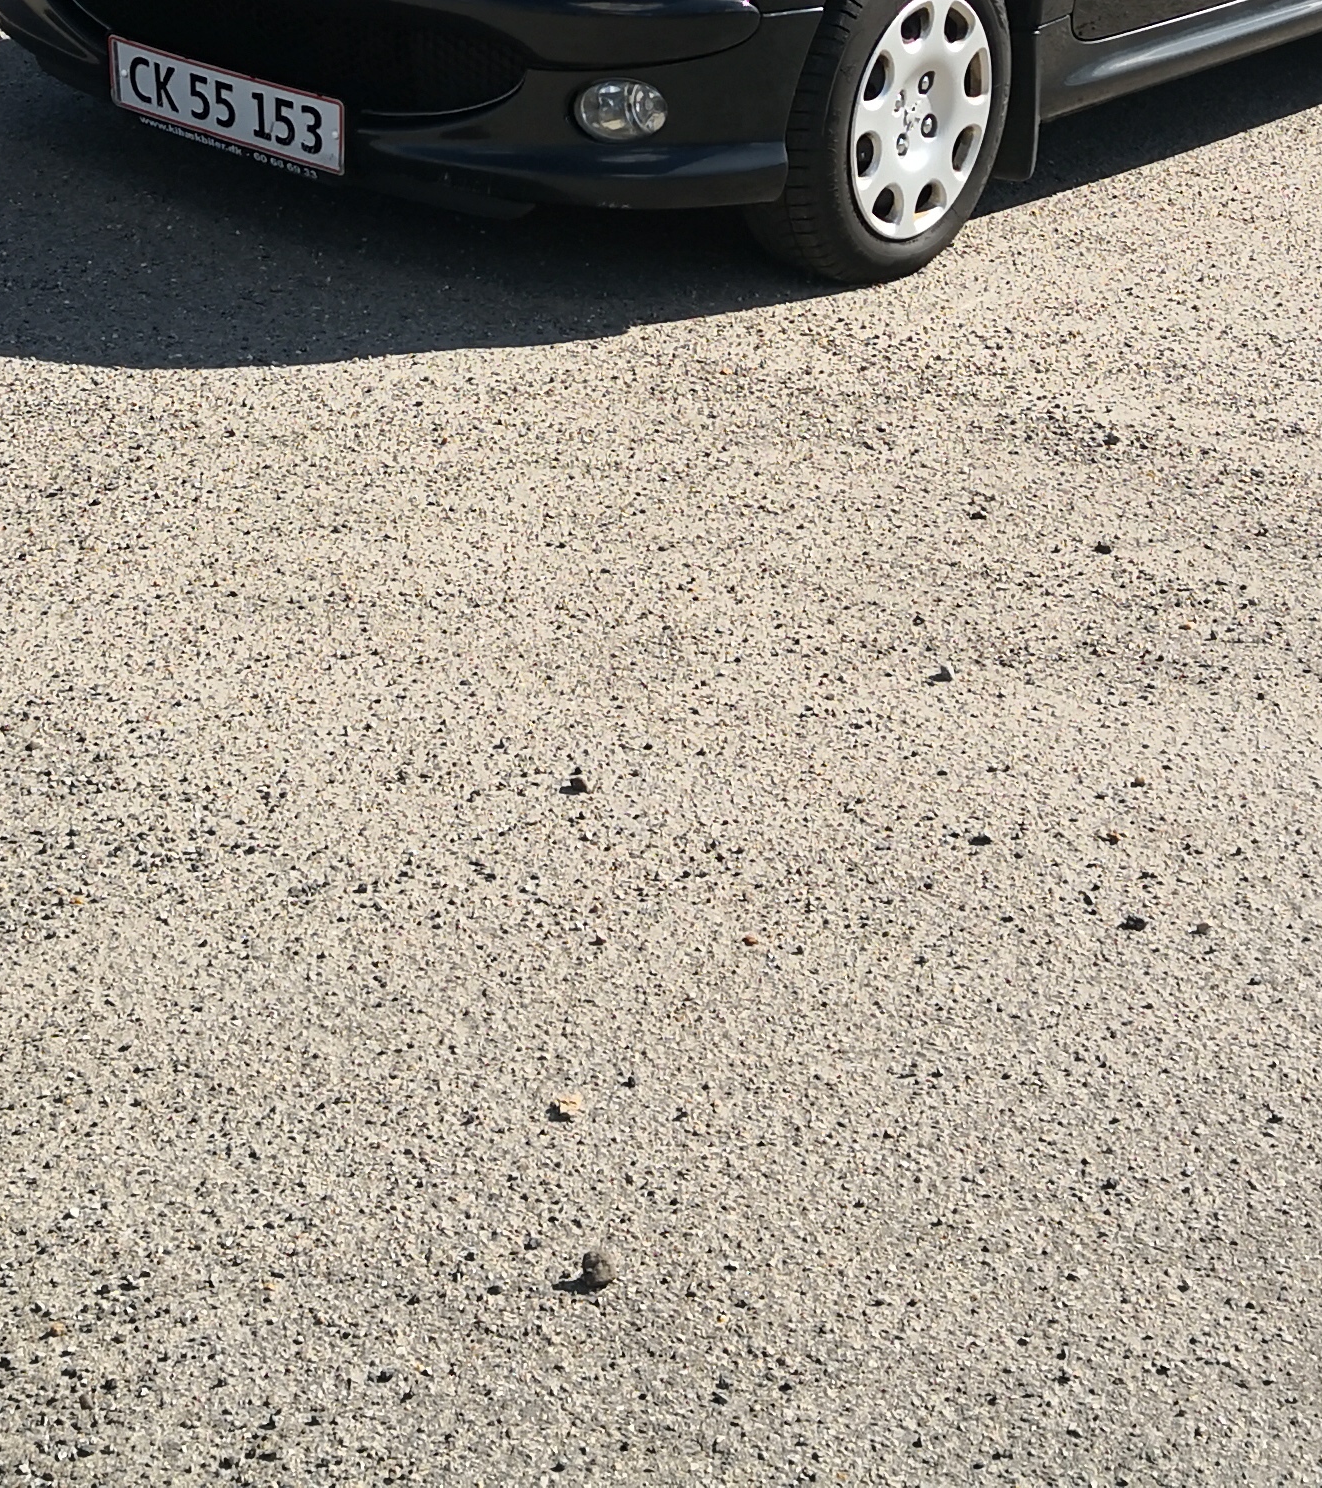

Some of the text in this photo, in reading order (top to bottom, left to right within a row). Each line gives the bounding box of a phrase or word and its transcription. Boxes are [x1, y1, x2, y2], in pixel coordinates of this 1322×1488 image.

[129, 56, 323, 155] CK 55 153
